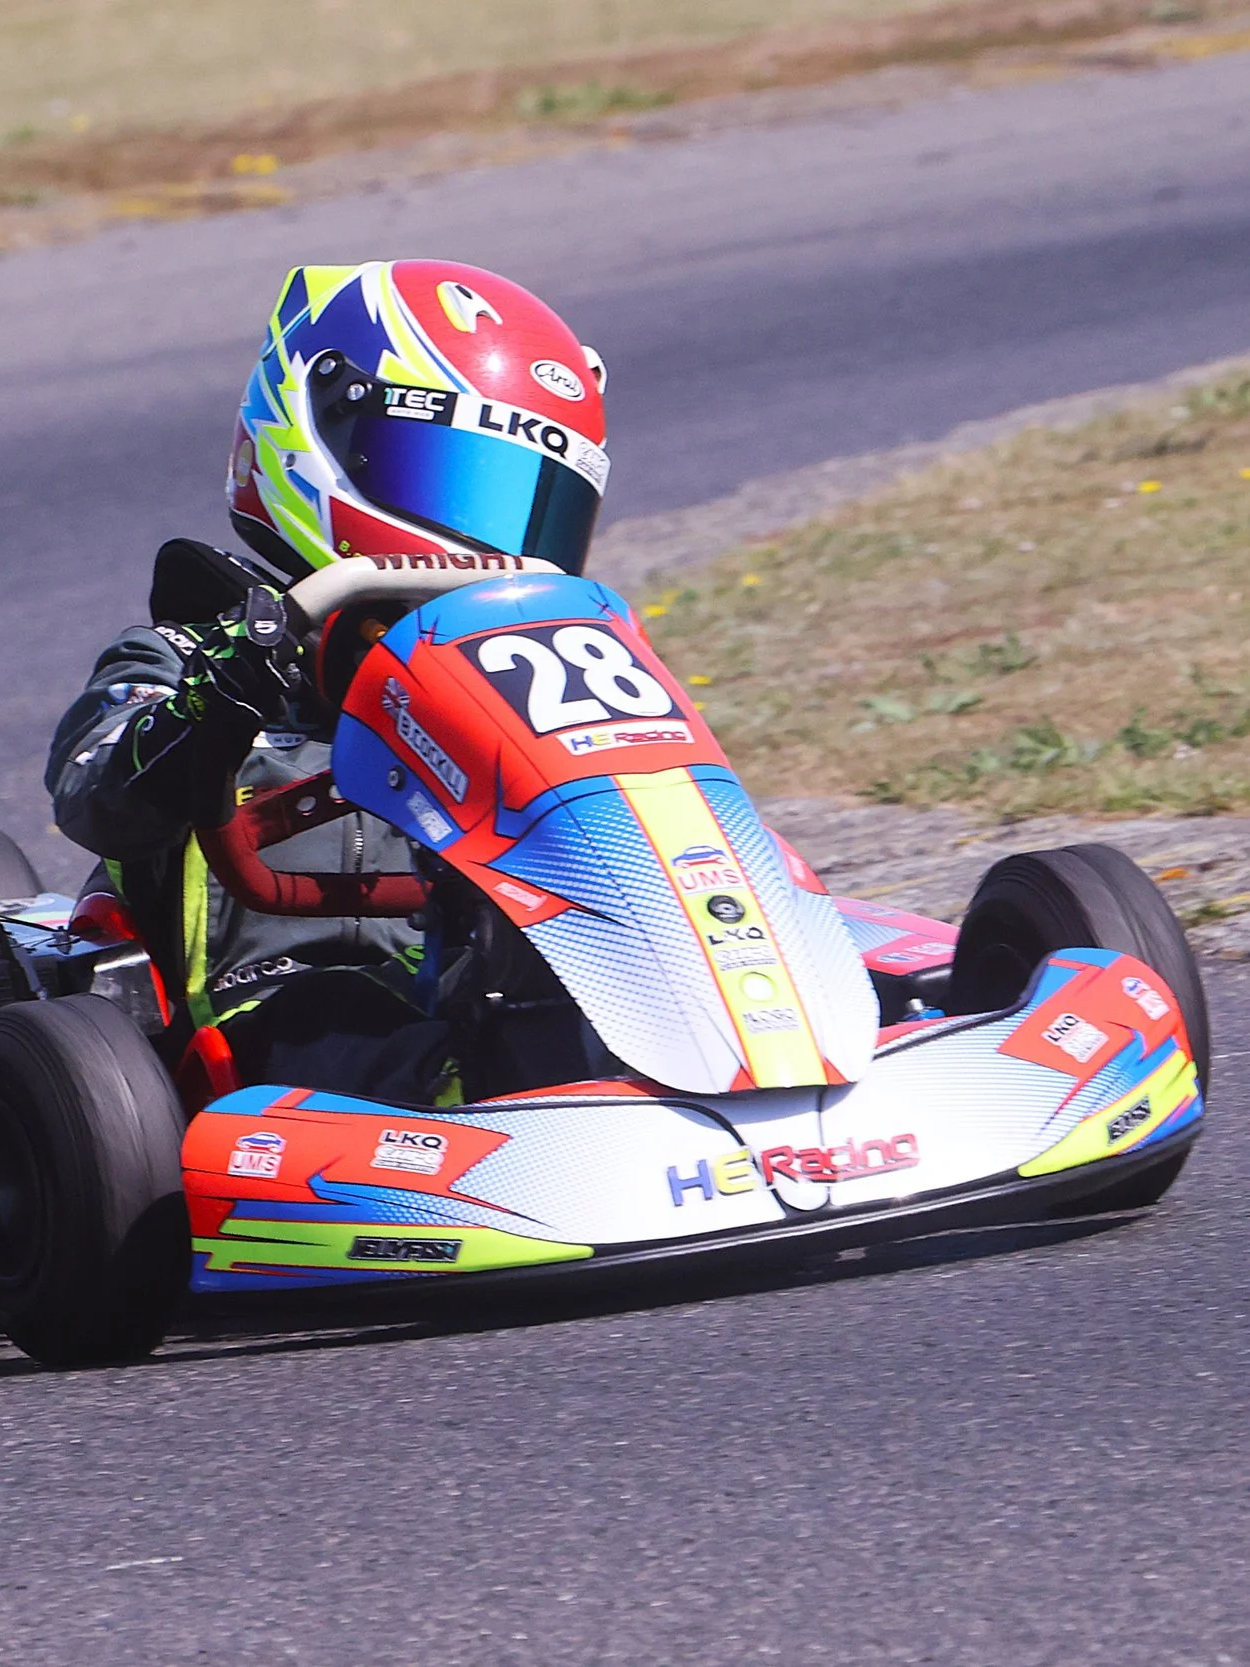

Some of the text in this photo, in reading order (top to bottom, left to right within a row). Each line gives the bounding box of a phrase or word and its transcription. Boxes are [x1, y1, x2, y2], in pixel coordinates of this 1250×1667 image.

[478, 404, 567, 460] LKQ
[478, 625, 673, 734] 28
[677, 868, 742, 890] UMS
[384, 1131, 443, 1150] LKQ
[234, 1154, 278, 1172] UMS
[667, 1133, 920, 1207] HE Racing
